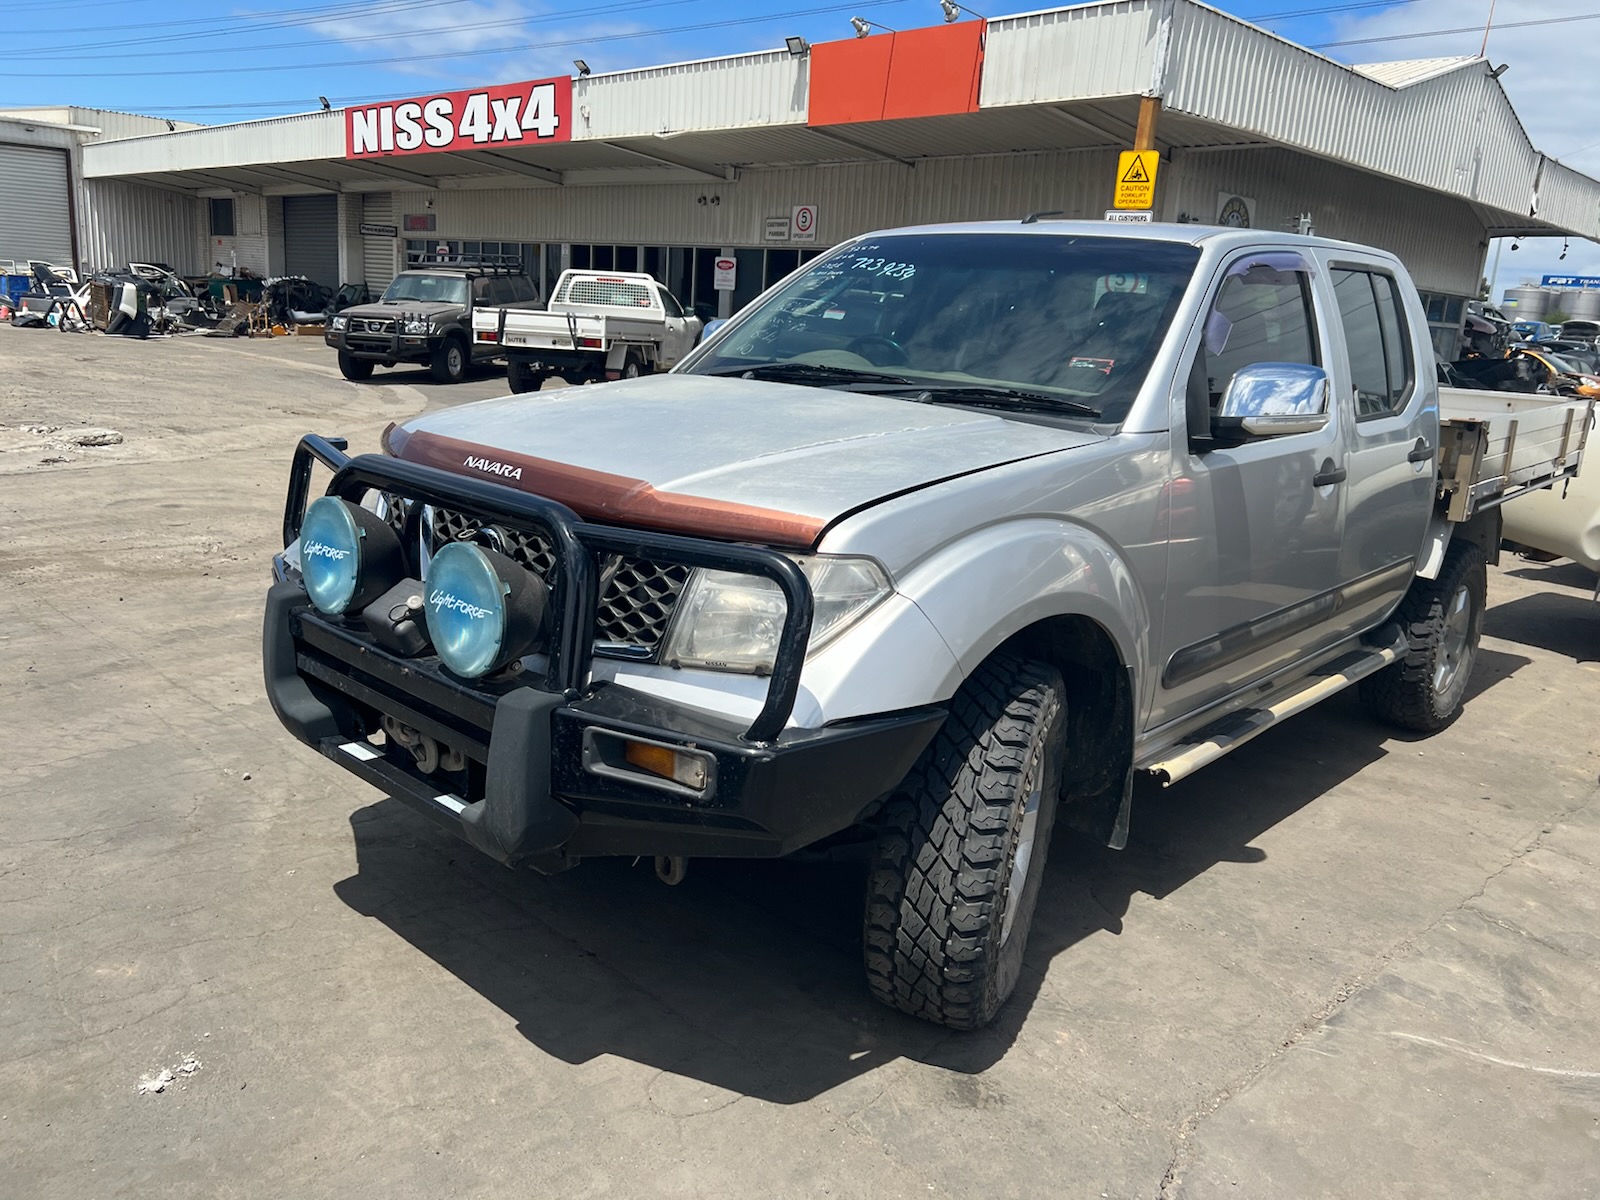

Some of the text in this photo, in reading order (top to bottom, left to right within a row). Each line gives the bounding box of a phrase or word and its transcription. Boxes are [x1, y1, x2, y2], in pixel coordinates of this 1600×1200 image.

[353, 83, 559, 154] NISS 4x4
[801, 211, 808, 224] 5
[361, 226, 396, 234] Reception
[463, 456, 522, 480] NAVARA
[430, 589, 493, 620] LightFORCE
